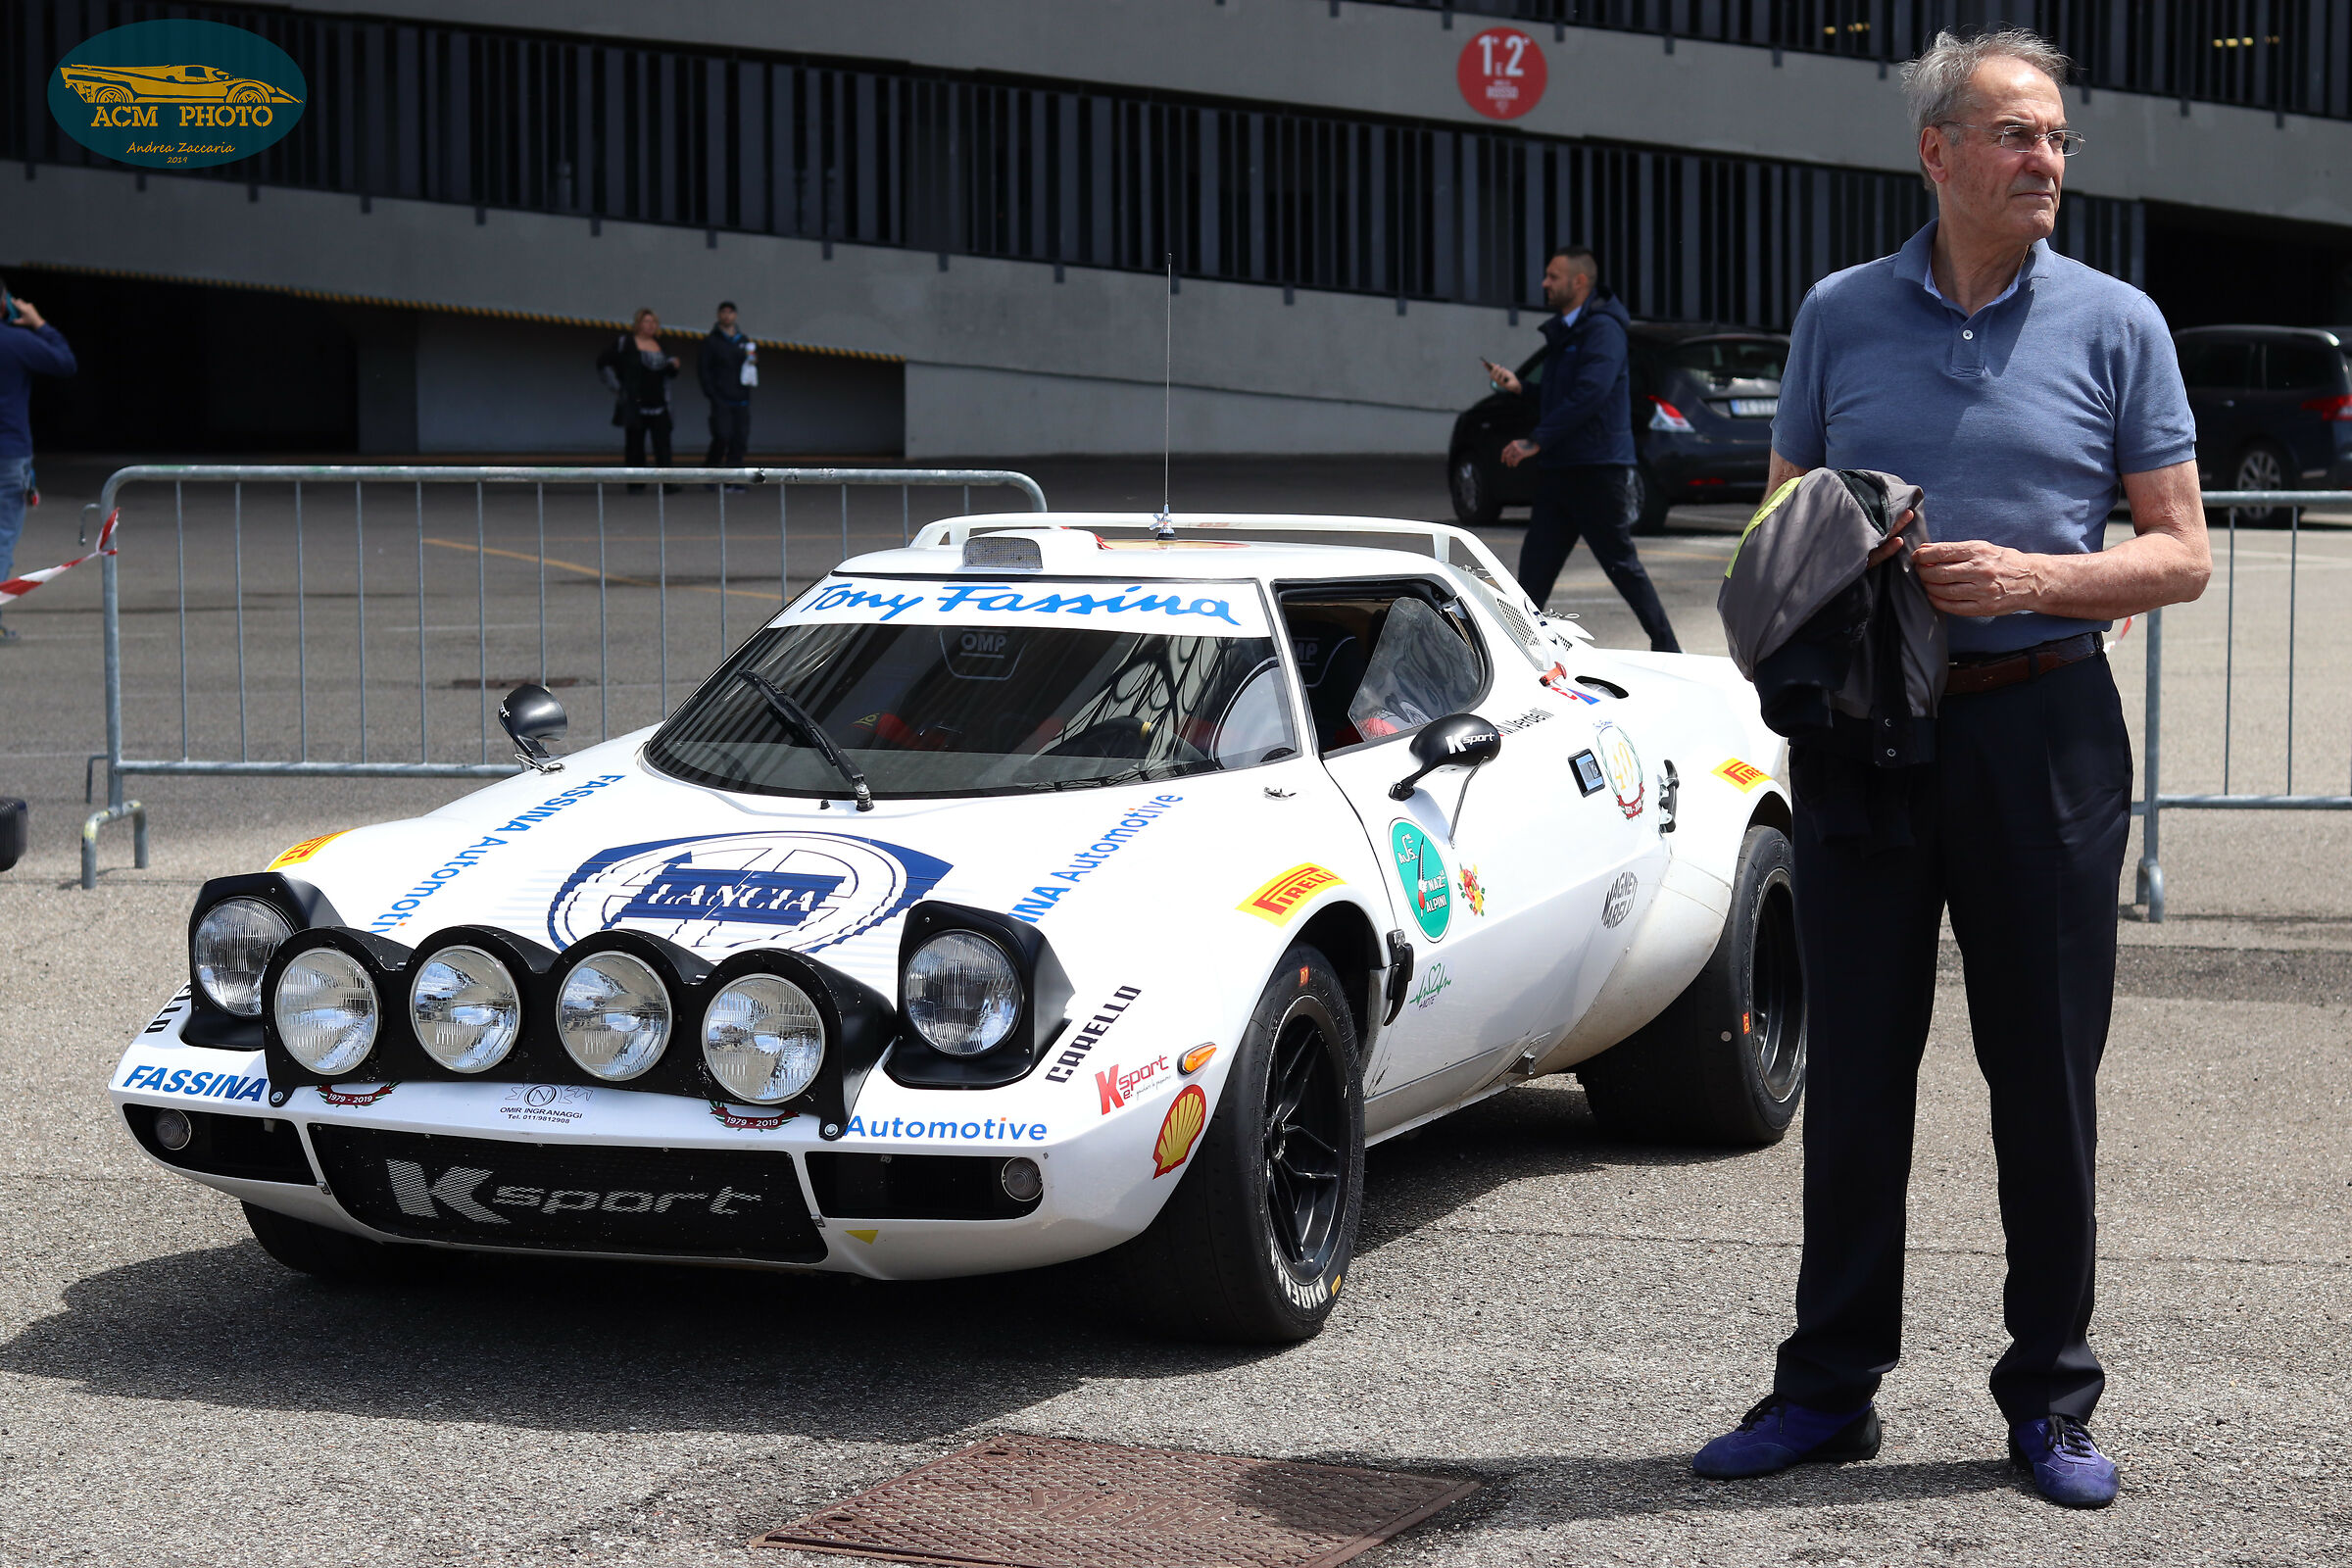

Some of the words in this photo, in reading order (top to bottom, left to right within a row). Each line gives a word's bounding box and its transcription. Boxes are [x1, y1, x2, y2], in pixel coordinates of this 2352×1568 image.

[800, 583, 923, 621] Tony
[938, 584, 1242, 626] Fassina
[959, 632, 1007, 653] OMP
[494, 774, 627, 832] FASSINA
[1050, 794, 1184, 882] Automotive
[645, 882, 818, 913] LANCIA
[1252, 867, 1339, 915] PIRELLI
[1425, 894, 1447, 913] ALPINI
[1045, 985, 1142, 1083] CARELLO
[122, 1065, 269, 1102] FASSINA
[844, 1115, 1048, 1141] Automotive
[328, 1093, 346, 1102] 1979
[353, 1095, 373, 1103] 2019
[524, 1107, 583, 1119] INGRANAGGI
[726, 1116, 747, 1126] 1979
